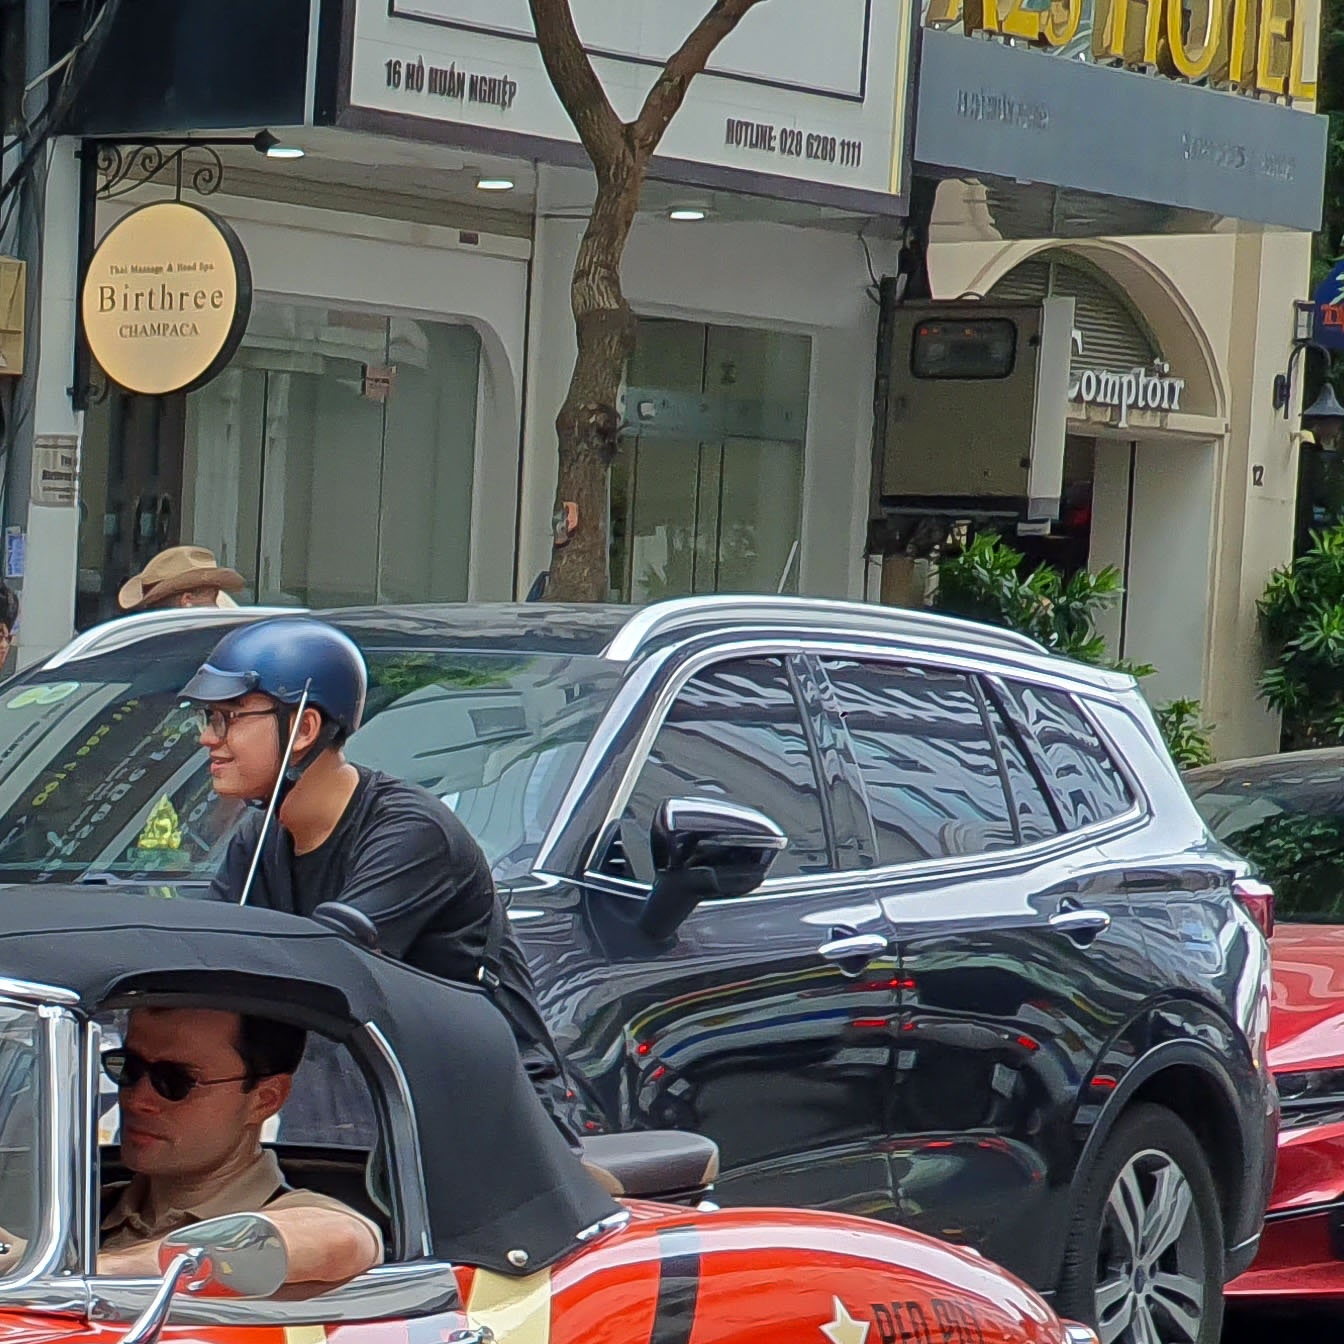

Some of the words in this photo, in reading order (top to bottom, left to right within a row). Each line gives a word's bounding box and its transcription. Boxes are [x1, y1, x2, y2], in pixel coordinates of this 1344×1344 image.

[385, 58, 401, 89] 16
[779, 127, 803, 157] 028
[806, 133, 837, 163] 6288
[839, 139, 862, 168] 1111
[98, 284, 224, 312] Birthree
[119, 323, 199, 338] CHAMPACA
[1253, 465, 1263, 486] 12
